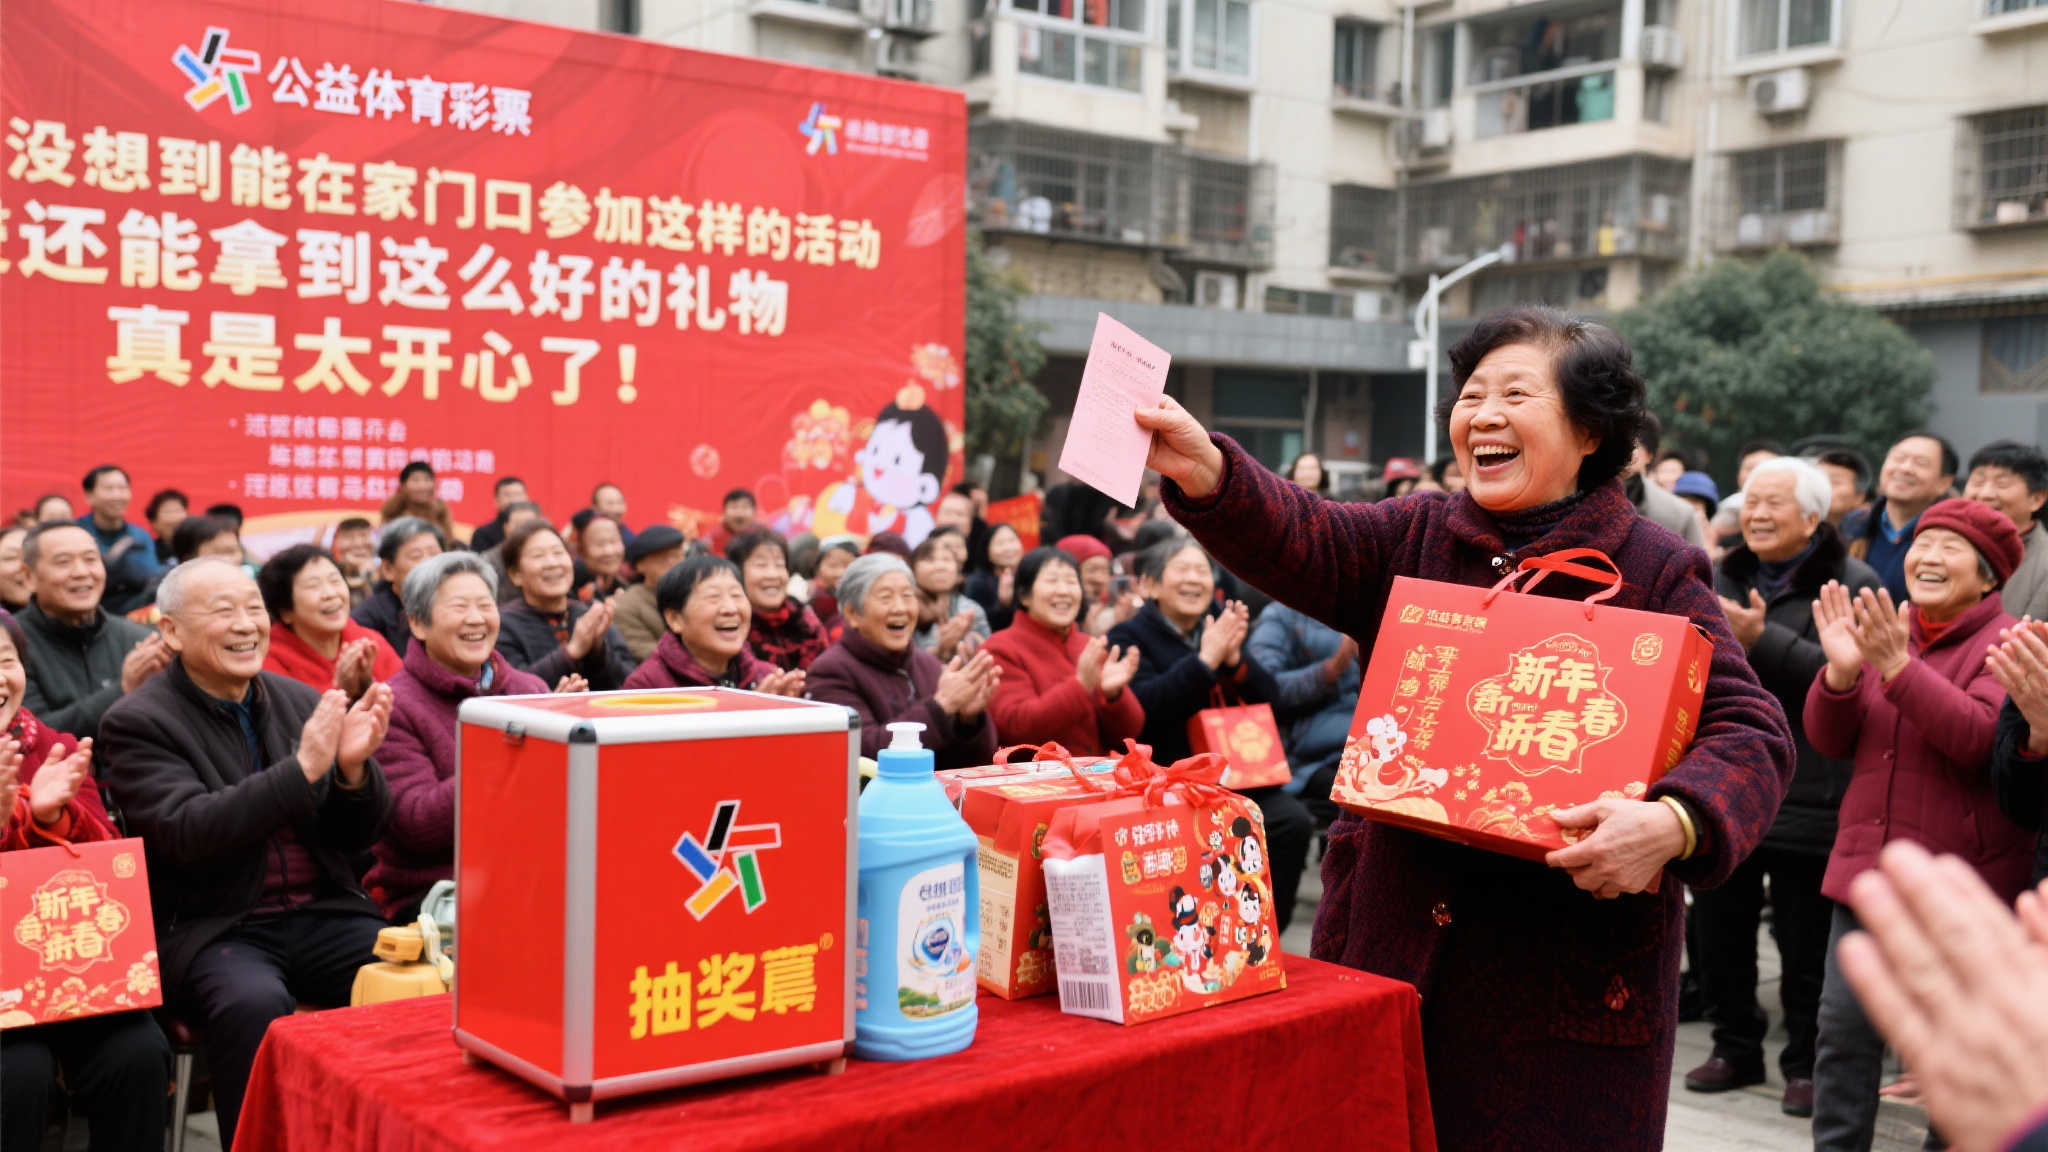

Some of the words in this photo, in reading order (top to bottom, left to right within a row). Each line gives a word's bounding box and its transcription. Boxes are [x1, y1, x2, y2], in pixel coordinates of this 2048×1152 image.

[267, 57, 533, 136] 公益体育彩票
[6, 117, 882, 270] 没想到能在家门口参加这样的活动
[0, 200, 789, 337] 还能拿到这么好的礼物
[107, 304, 638, 406] 真是太开心了！
[1510, 653, 1597, 703] 新年
